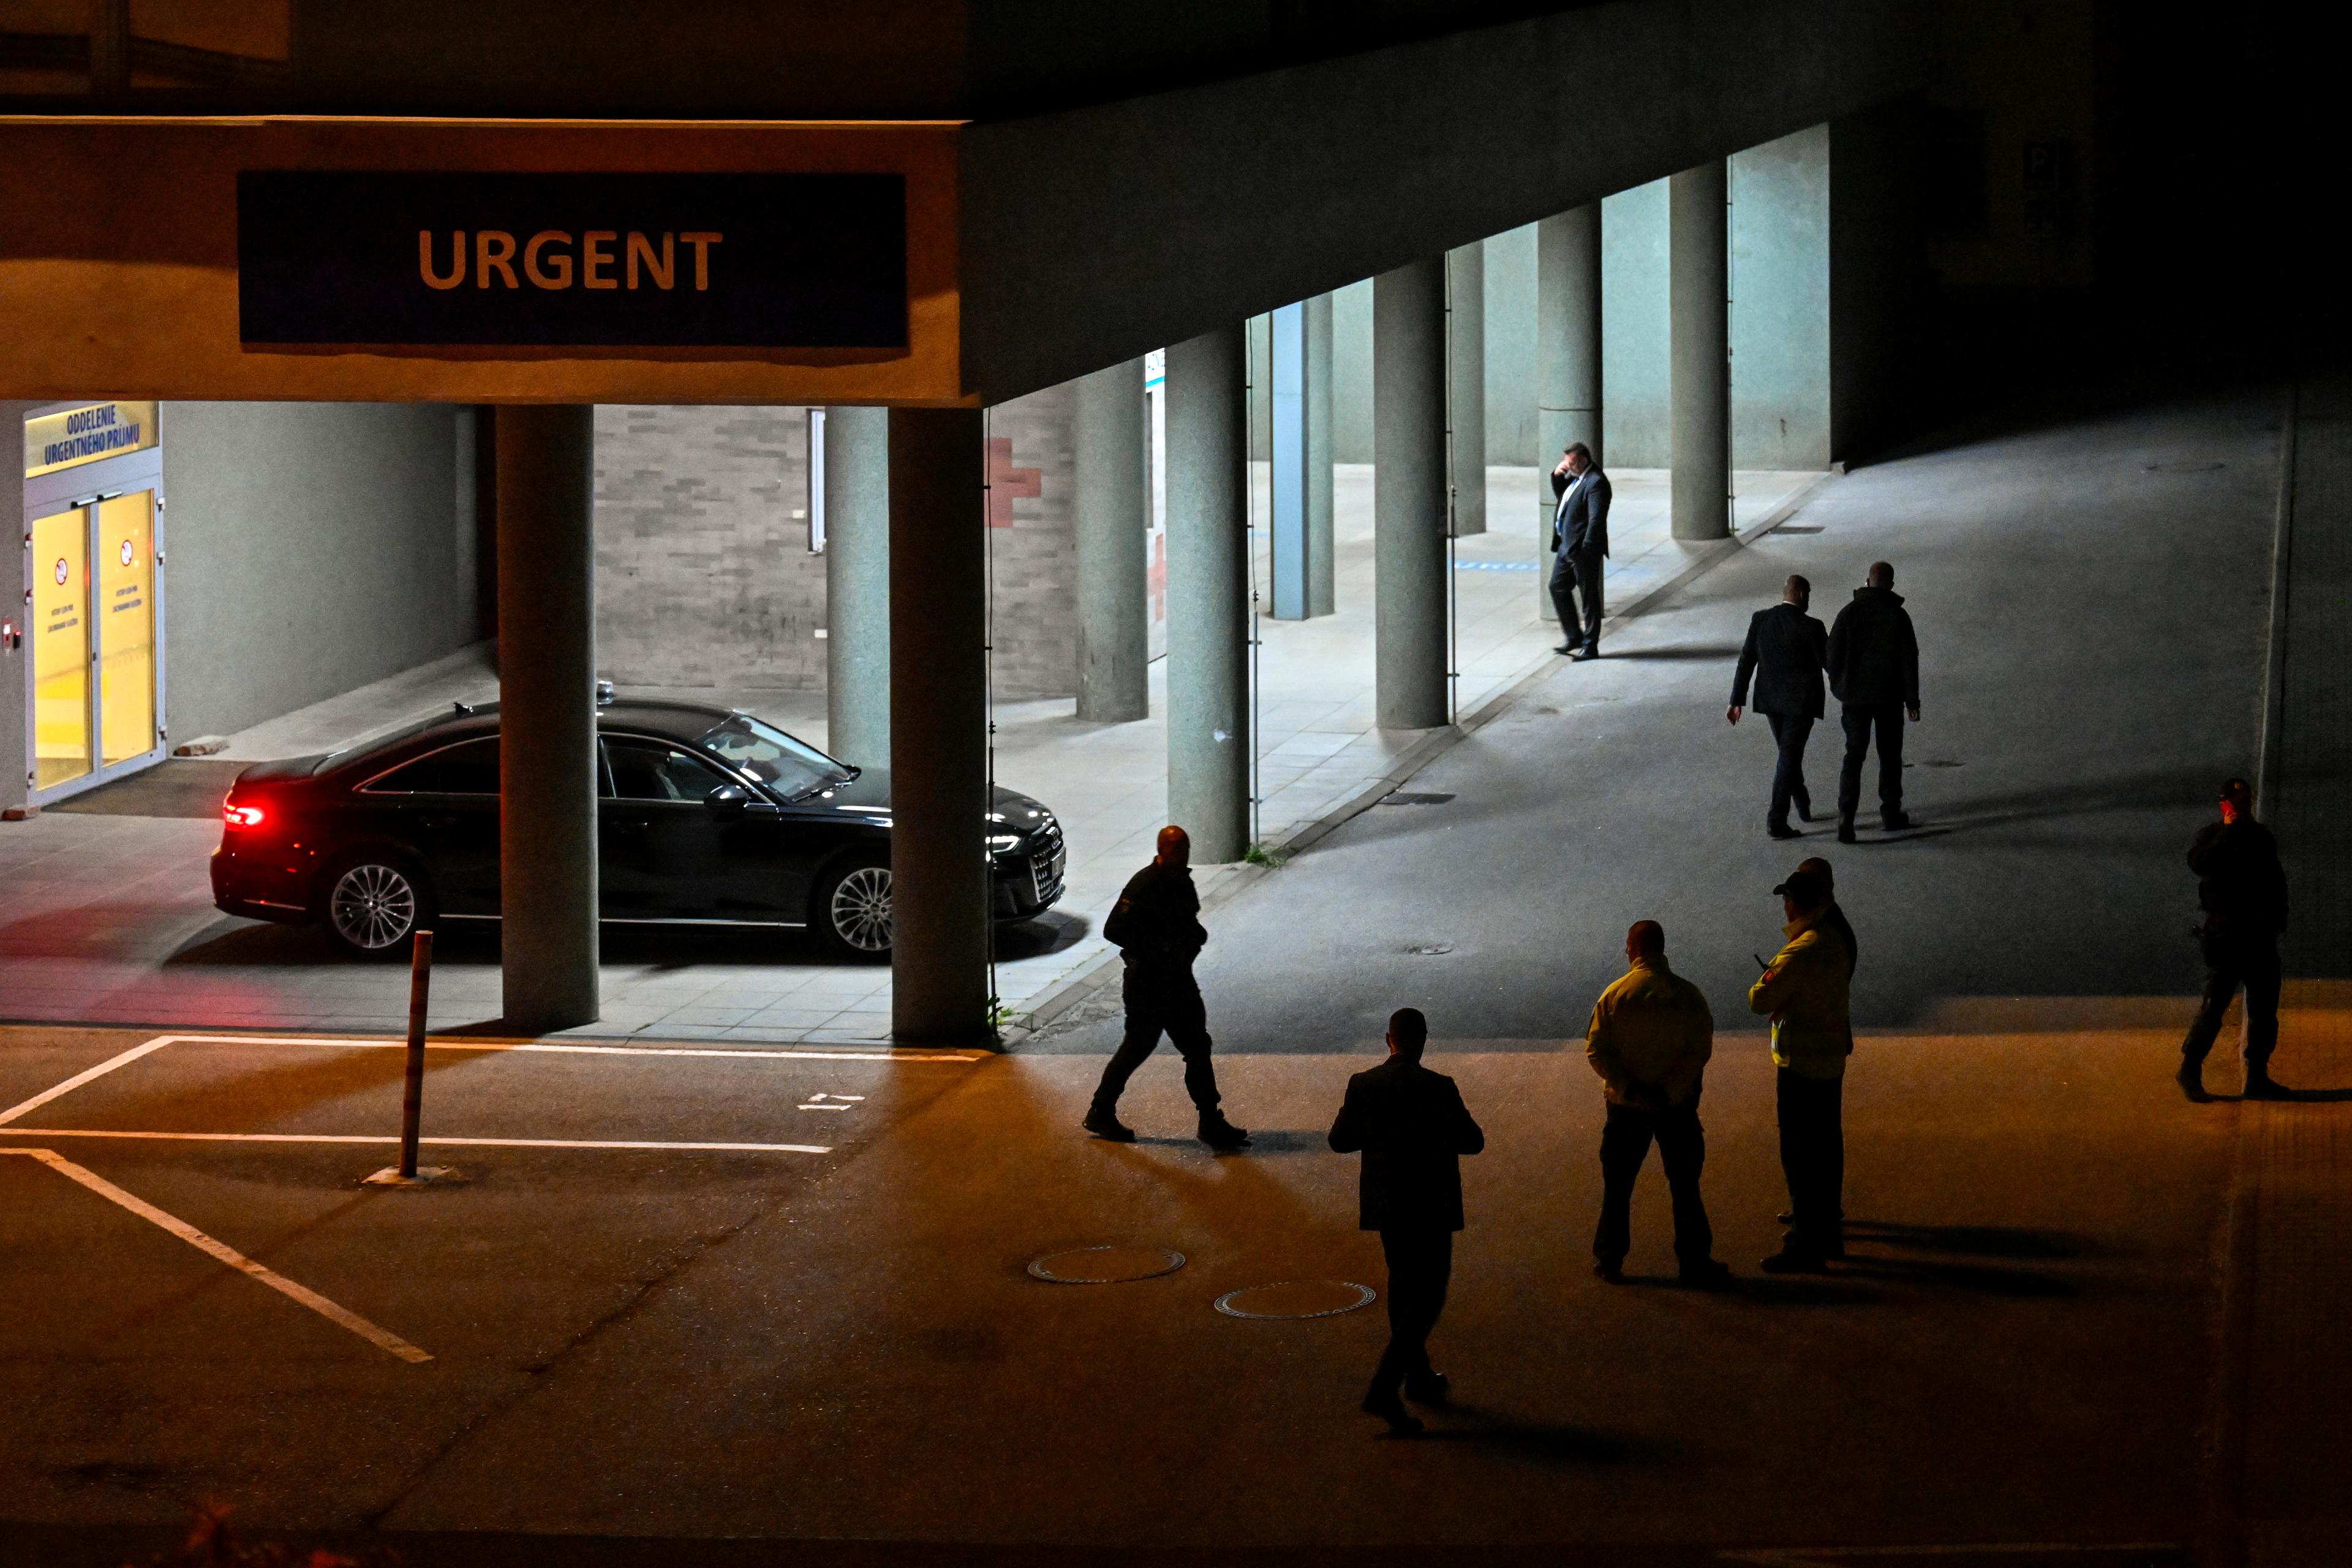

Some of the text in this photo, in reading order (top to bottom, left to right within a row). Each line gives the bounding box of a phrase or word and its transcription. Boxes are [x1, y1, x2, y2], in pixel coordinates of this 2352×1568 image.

[419, 230, 723, 290] URGENT
[67, 404, 116, 435] ODDELENIE
[45, 423, 140, 465] URGENTNÉHO PRÍJMU
